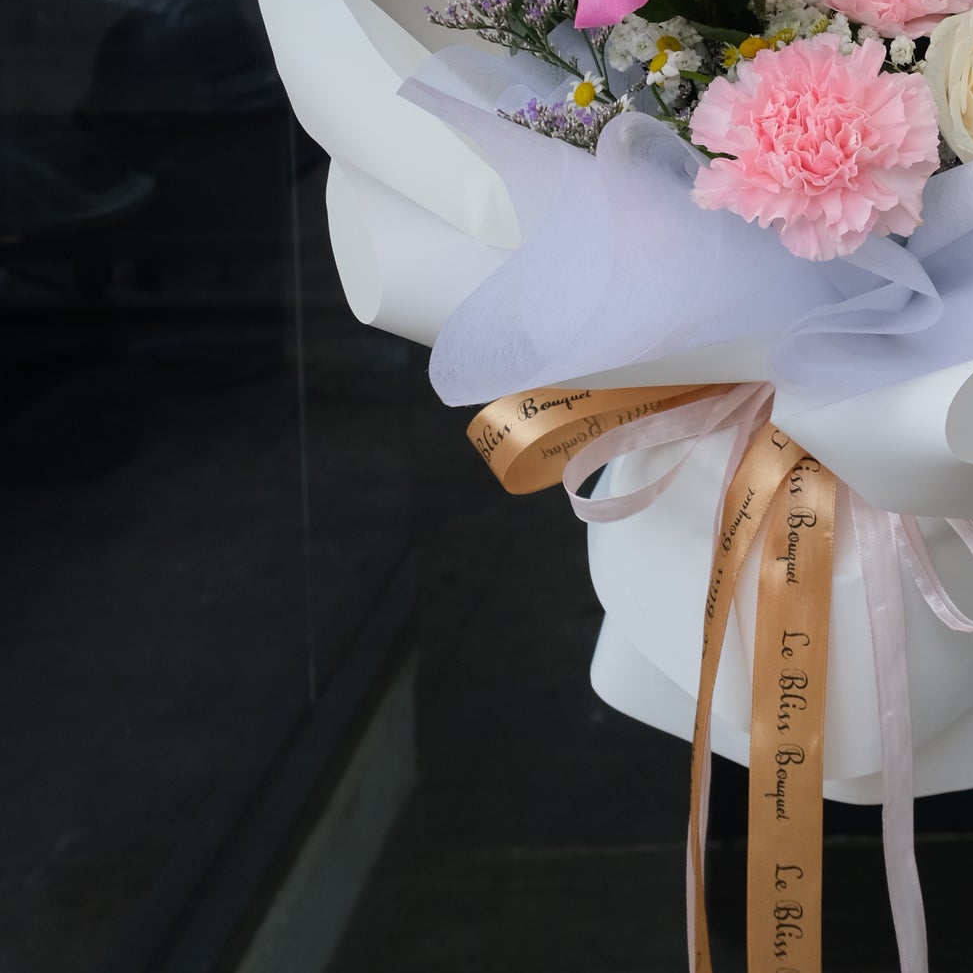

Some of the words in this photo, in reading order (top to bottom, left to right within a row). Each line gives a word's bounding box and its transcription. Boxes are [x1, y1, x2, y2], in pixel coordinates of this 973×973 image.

[517, 390, 593, 422] Bouquet
[776, 506, 817, 586] Bouquet
[781, 630, 810, 660] Le
[776, 668, 808, 733] Bliss
[764, 743, 805, 821] Bouquet
[774, 864, 804, 893] Le
[772, 899, 804, 961] Bliss
